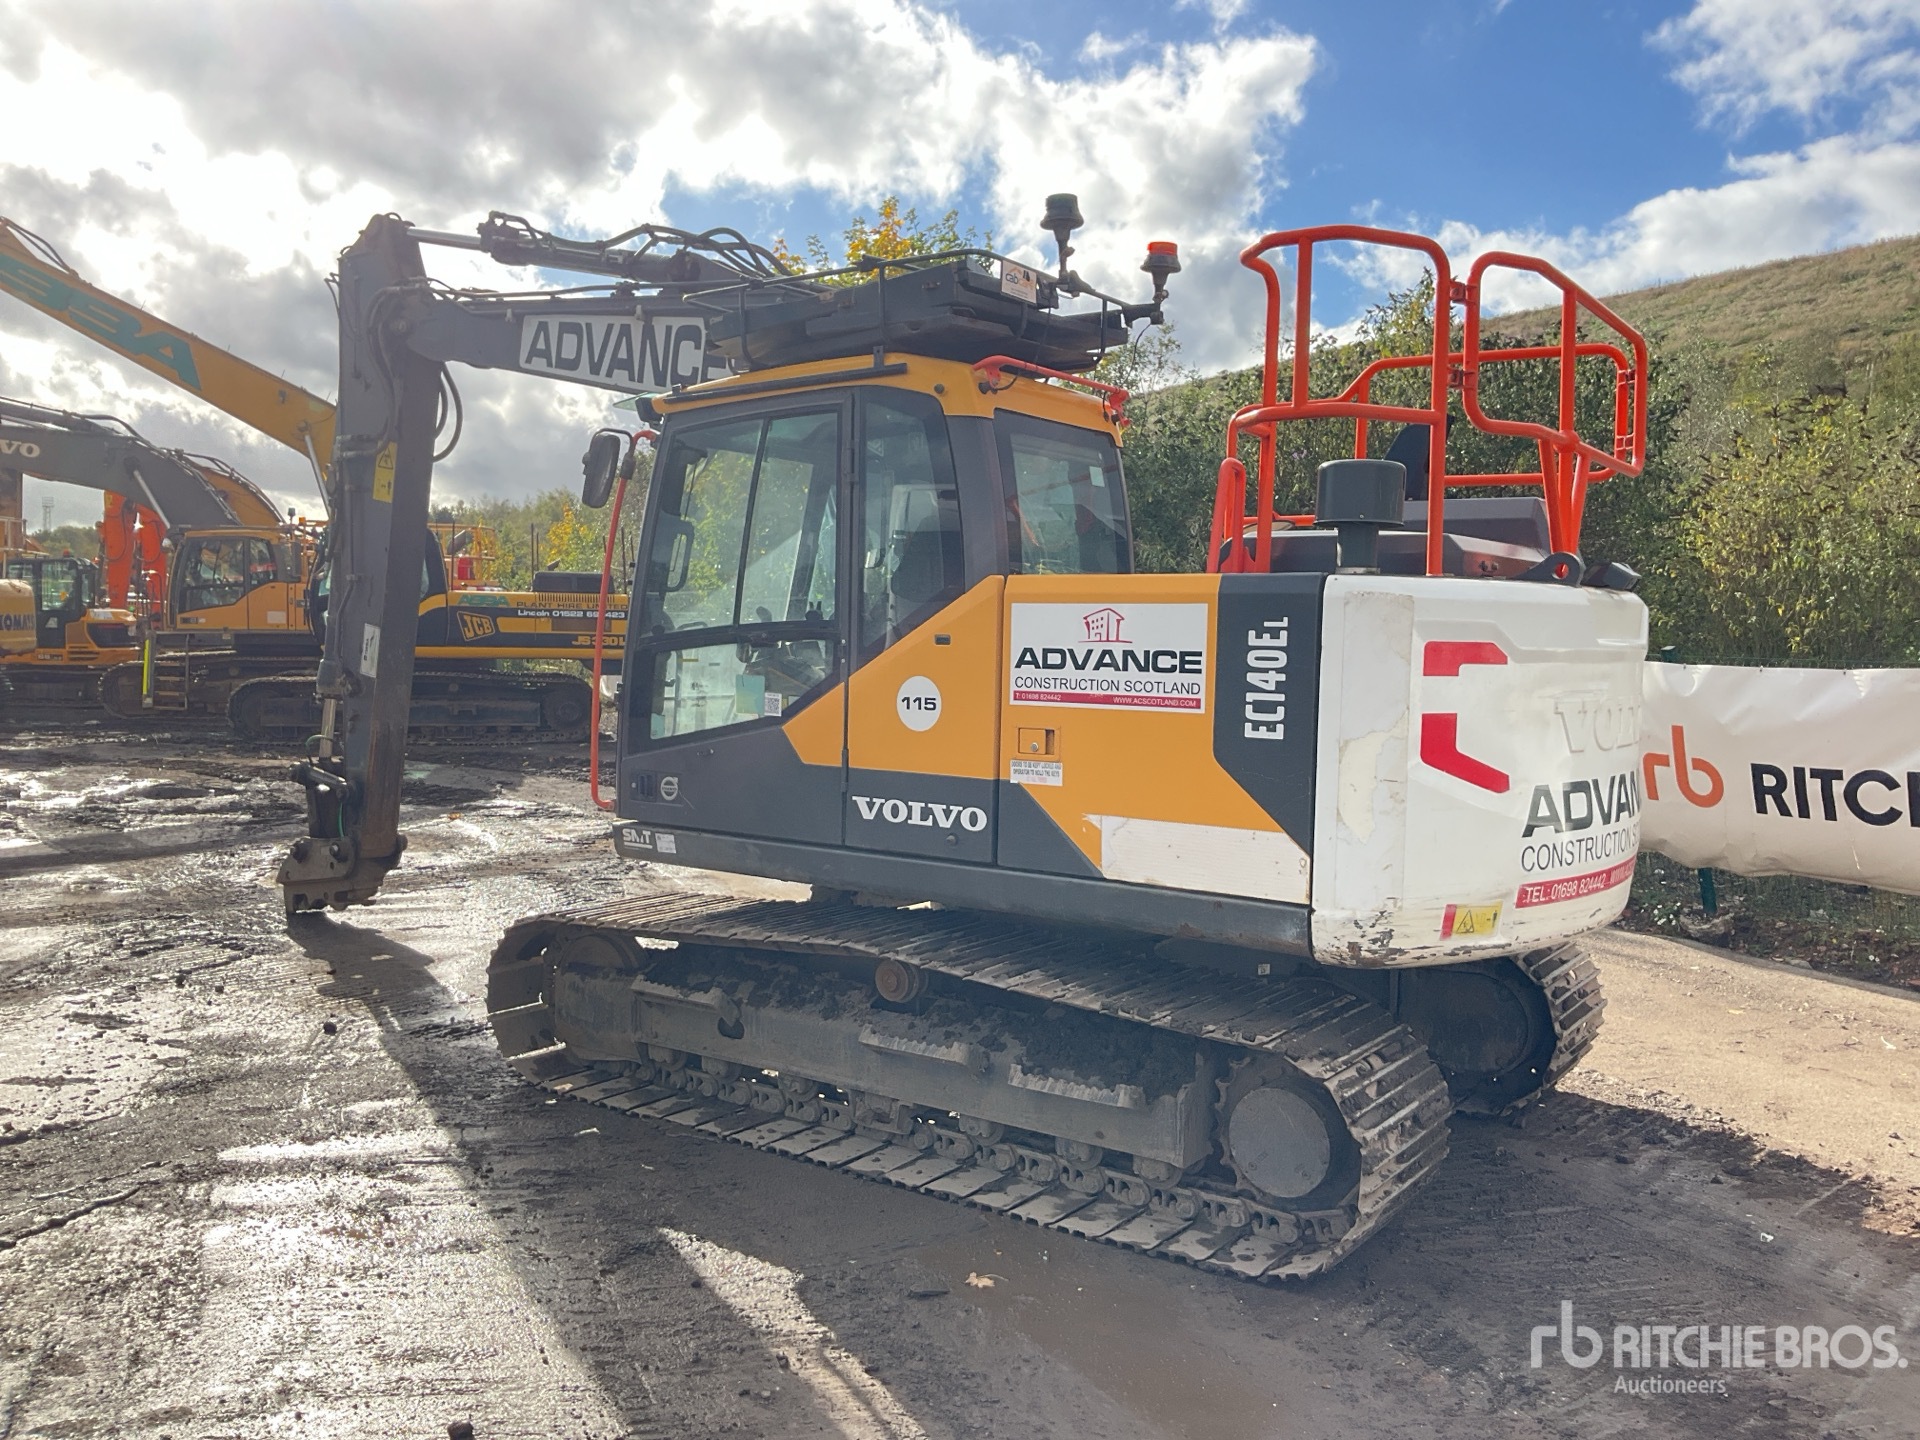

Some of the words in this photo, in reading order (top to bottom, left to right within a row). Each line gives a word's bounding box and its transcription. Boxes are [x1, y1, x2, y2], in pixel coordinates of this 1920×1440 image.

[463, 614, 492, 638] JCB
[518, 609, 550, 617] Lincoln
[552, 610, 584, 618] 01522
[1014, 647, 1202, 674] ADVANCE
[1015, 676, 1120, 692] CONSTRUCTION
[1124, 680, 1201, 695] SCOTLAND
[1244, 616, 1289, 740] EC140EL
[901, 697, 937, 711] 115
[1750, 762, 1920, 828] RITC
[852, 796, 988, 831] VOLVO
[622, 828, 651, 843] SMT
[1551, 879, 1578, 900] 01698
[1578, 873, 1607, 894] 824442
